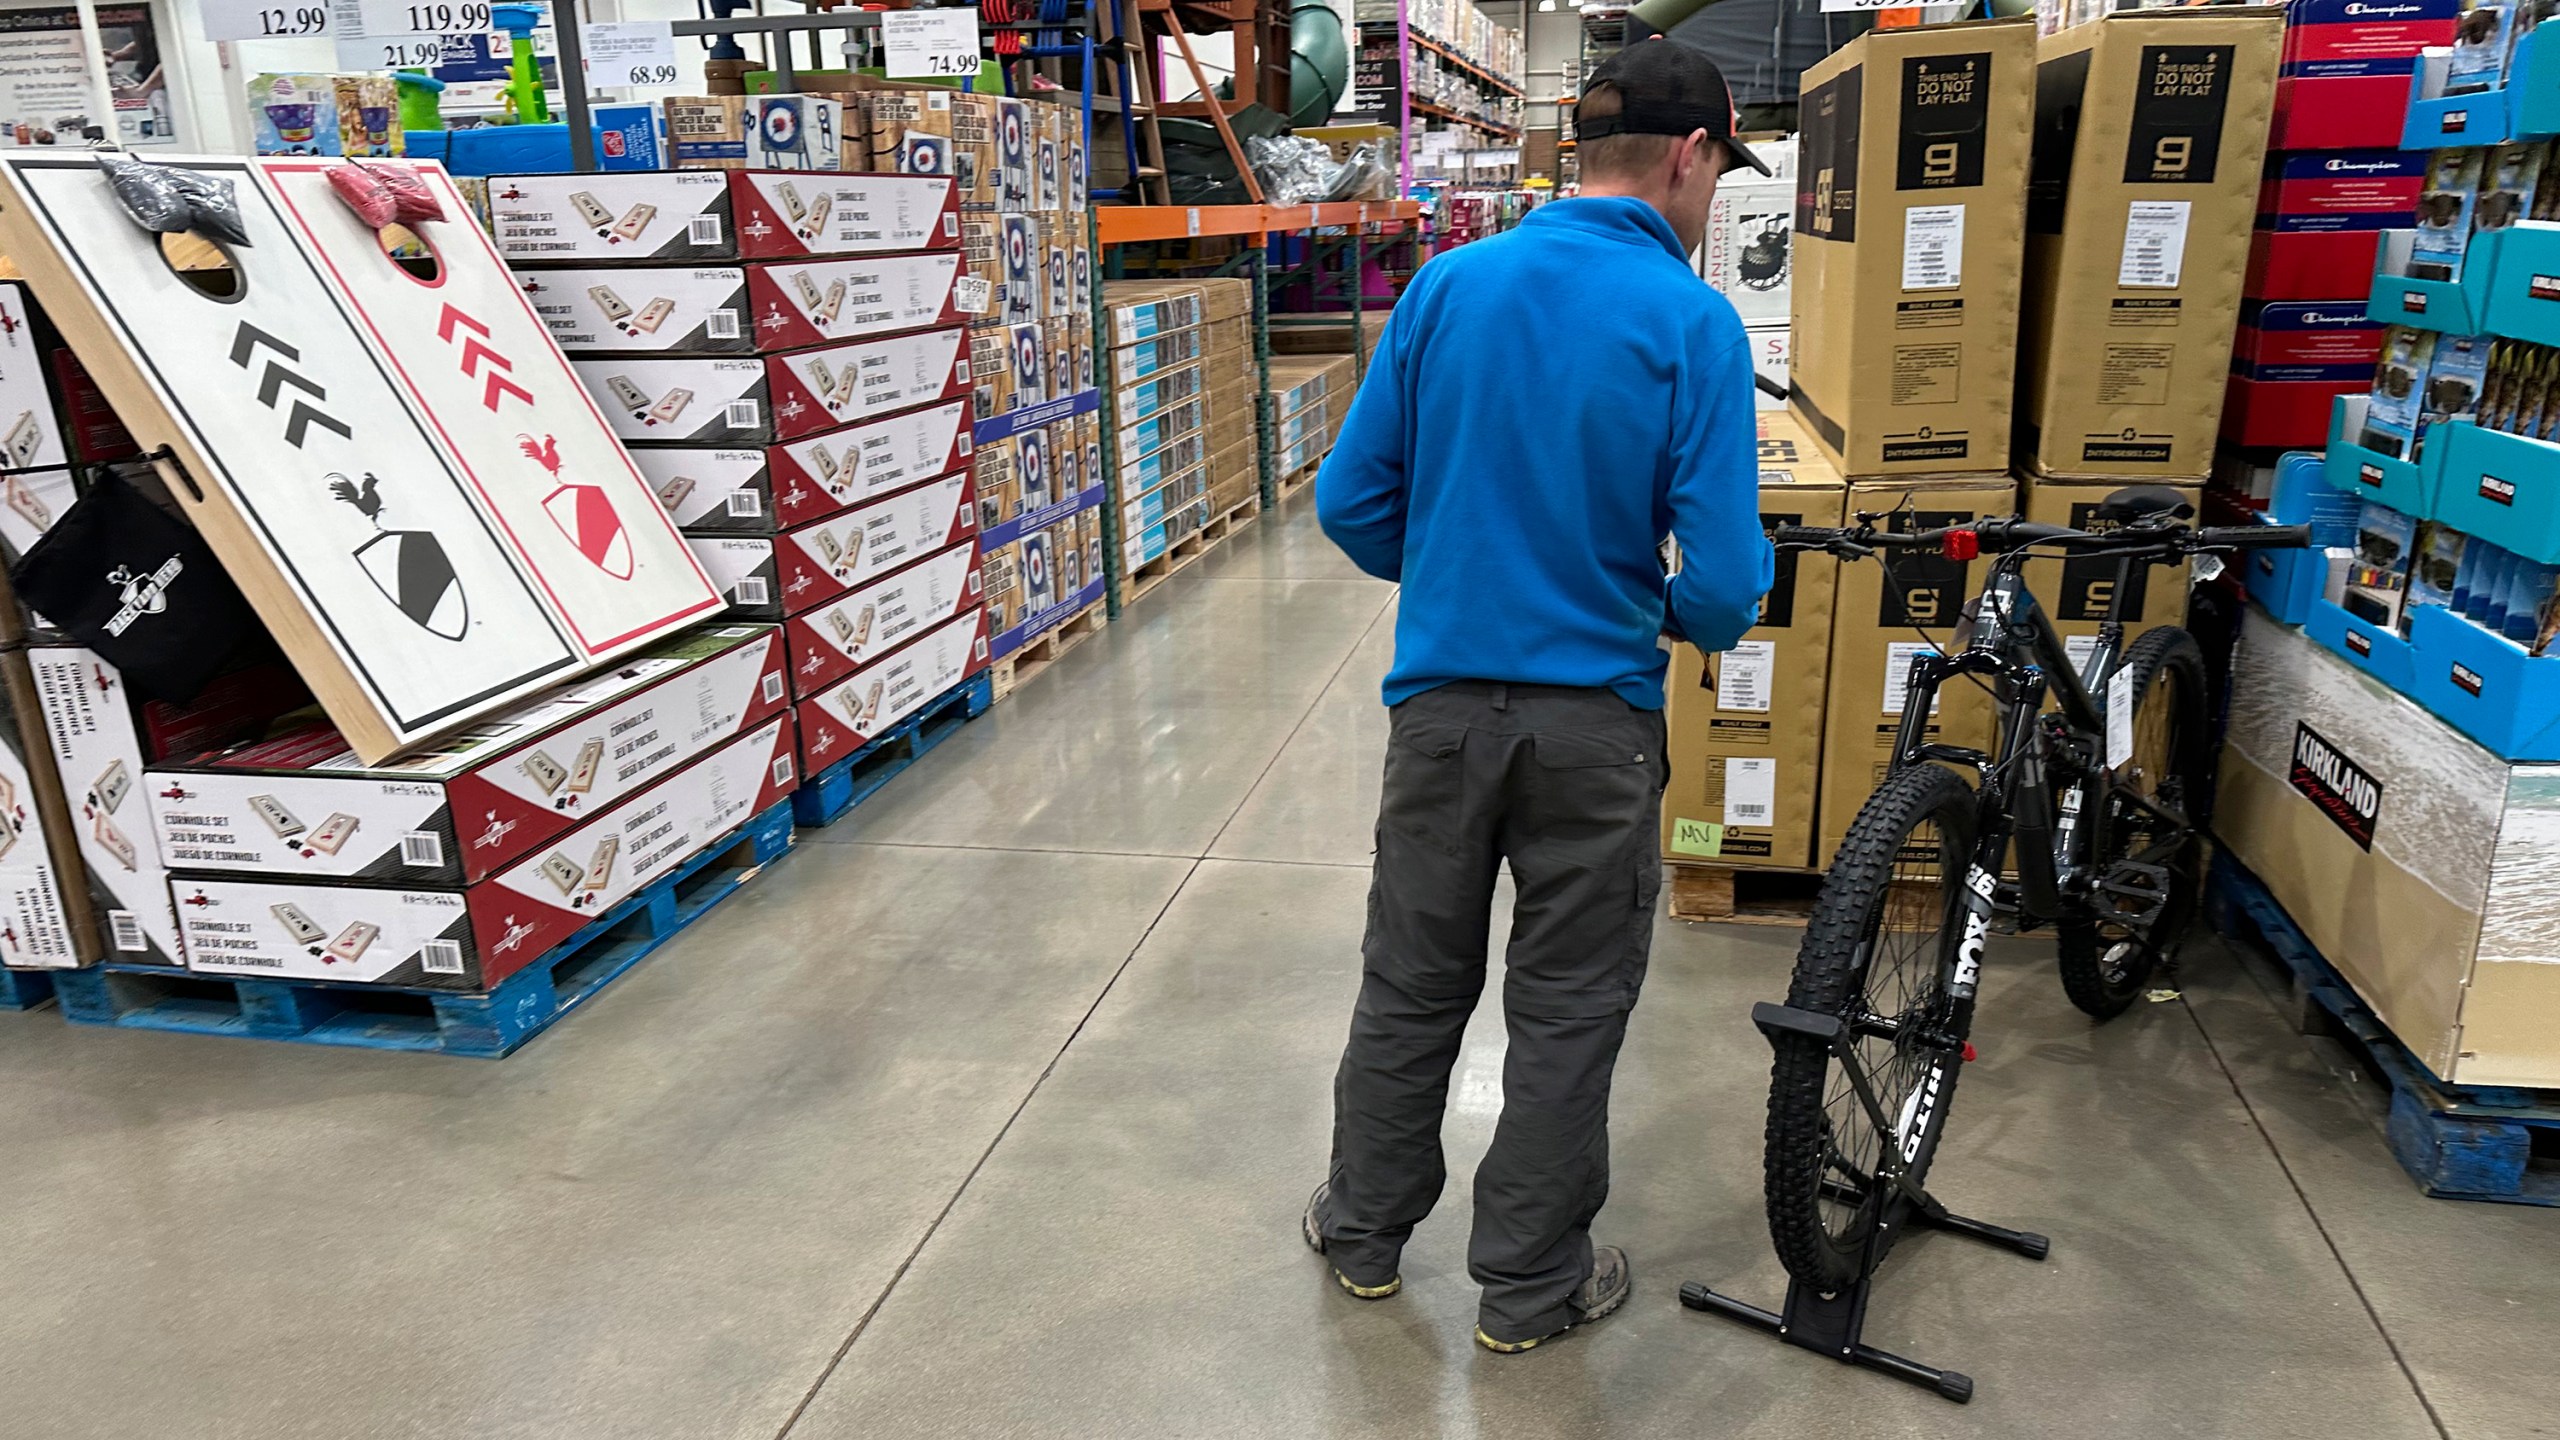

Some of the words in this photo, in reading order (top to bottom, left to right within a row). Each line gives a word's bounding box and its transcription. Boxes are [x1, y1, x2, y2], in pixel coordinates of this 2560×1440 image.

[2344, 2, 2422, 17] Champion
[259, 8, 326, 35] 12.99
[407, 3, 491, 31] 119.99
[384, 43, 439, 67] 21.99
[928, 54, 978, 74] 74.99
[2157, 64, 2179, 72] THIS
[2179, 64, 2200, 72] END
[2201, 64, 2217, 72] UP
[630, 65, 677, 84] 68.99
[1355, 74, 1383, 85] COM
[1919, 74, 1939, 82] THIS
[1940, 73, 1959, 81] END
[1960, 71, 1975, 80] UP
[2155, 72, 2179, 84] DO
[2181, 72, 2215, 84] NOT
[1917, 82, 1939, 95] DO
[1942, 80, 1974, 93] NOT
[2153, 85, 2180, 95] LAY
[2179, 85, 2212, 95] FLAT
[1917, 94, 1941, 106] LAY
[1941, 92, 1973, 104] FLAT
[1341, 141, 1350, 156] 5
[2325, 159, 2401, 173] Champion
[536, 305, 559, 314] NHOLE
[2301, 312, 2368, 326] Champio
[2296, 730, 2378, 819] KIRKLAND
[164, 815, 212, 826] CORNHOLE
[213, 816, 229, 827] SET
[200, 834, 235, 844] POCHES
[174, 850, 199, 860] JUEGO
[215, 852, 262, 863] CORNHOLE
[189, 921, 235, 932] CORNHOLE
[236, 922, 251, 933] SET
[223, 940, 258, 950] POCHES
[1953, 911, 1993, 985] FOX
[198, 955, 221, 965] JUEGO
[237, 957, 284, 968] CORNHOLE
